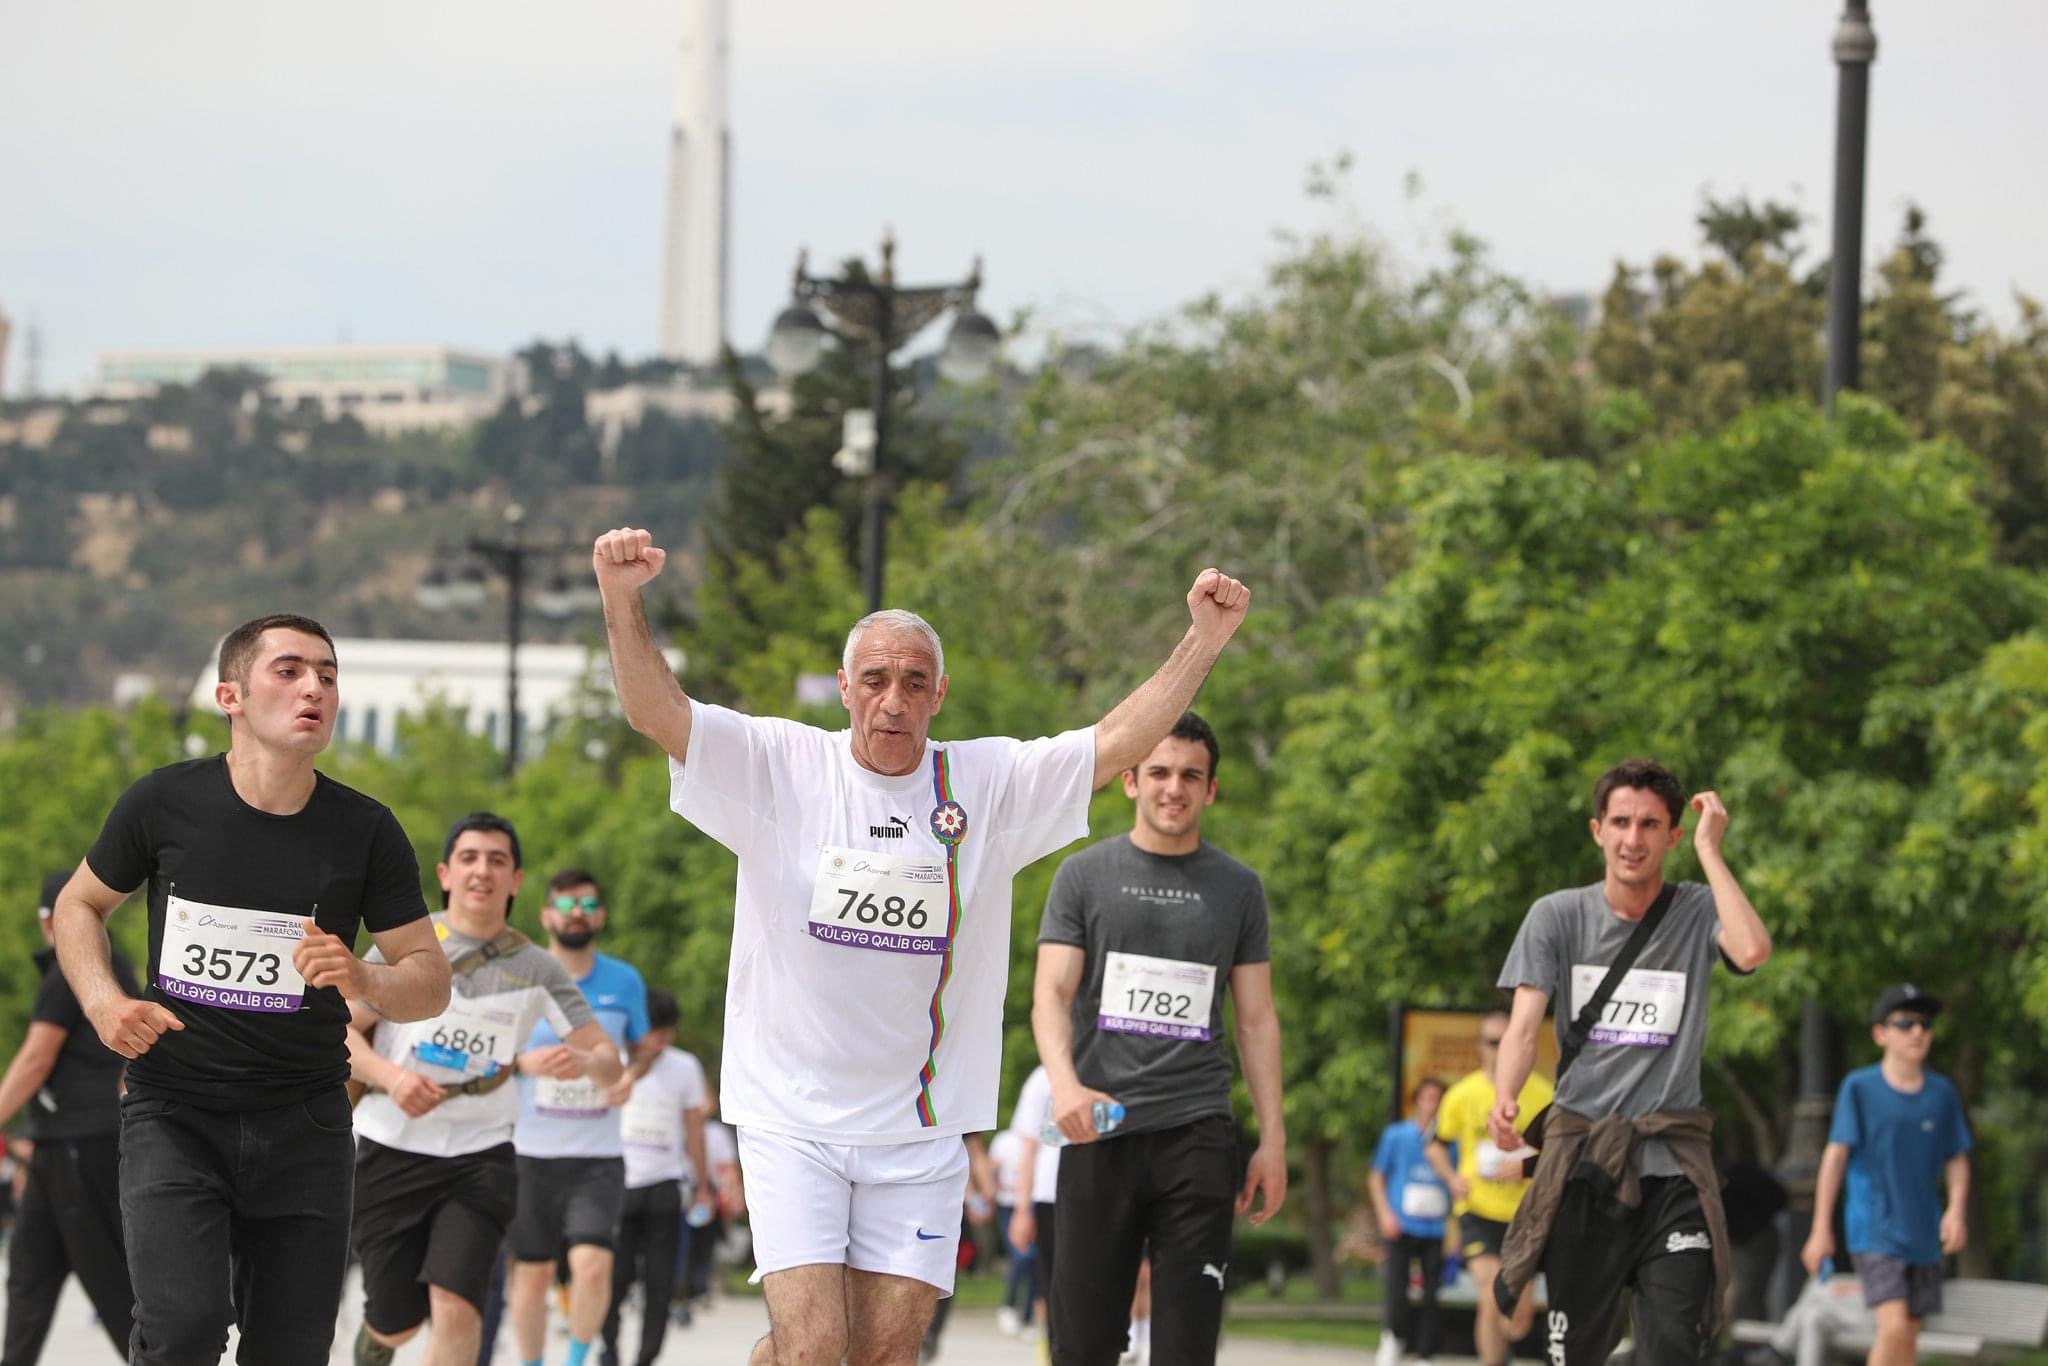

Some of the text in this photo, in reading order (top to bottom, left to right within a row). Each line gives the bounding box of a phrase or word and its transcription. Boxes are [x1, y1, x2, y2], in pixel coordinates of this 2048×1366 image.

[870, 826, 903, 839] PUMA
[837, 888, 928, 930] 7686
[816, 922, 937, 951] KÜLƏYƏ QALİB GƏL
[182, 944, 281, 986] 3573
[165, 979, 291, 1009] KÜLƏYƏ QALİB GƏL
[1127, 988, 1191, 1019] 1782
[1605, 1000, 1657, 1025] 778
[432, 1025, 496, 1056] 6861
